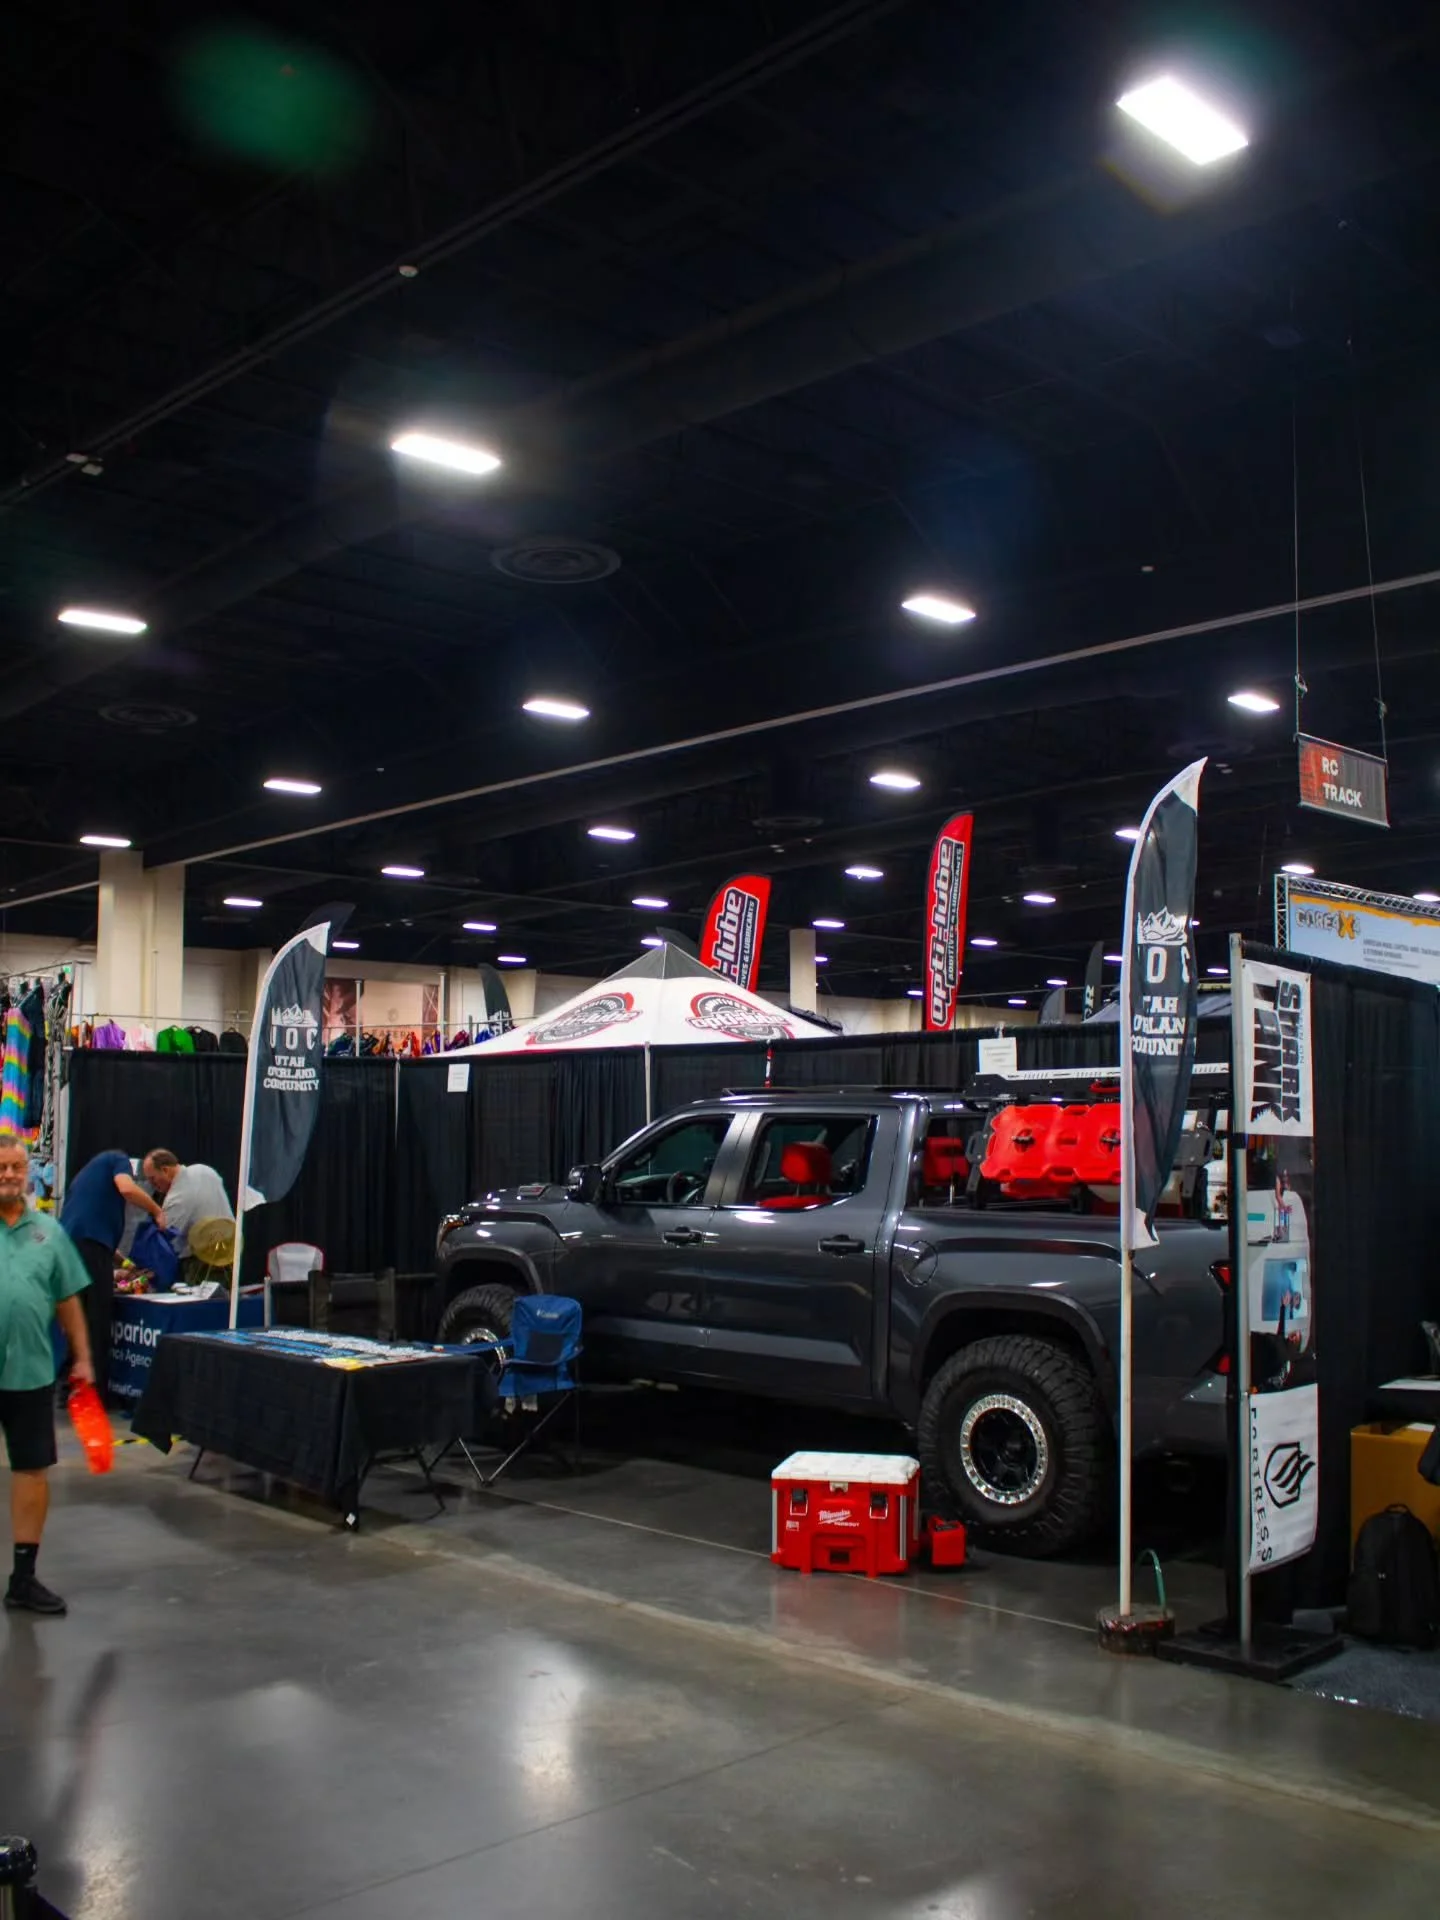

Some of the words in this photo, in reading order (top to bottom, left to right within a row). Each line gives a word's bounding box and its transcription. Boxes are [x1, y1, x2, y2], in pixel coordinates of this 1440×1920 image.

[1321, 756, 1339, 776] RC
[1322, 782, 1363, 808] TRACK
[715, 891, 742, 975] -lube
[743, 901, 755, 953] LUBRICANTS
[932, 842, 951, 1021] opti-lube
[740, 963, 750, 988] TIVES
[743, 954, 750, 962] &
[274, 1055, 305, 1067] UTAH
[1251, 979, 1282, 1123] TANK
[1279, 980, 1301, 1123] SHARK
